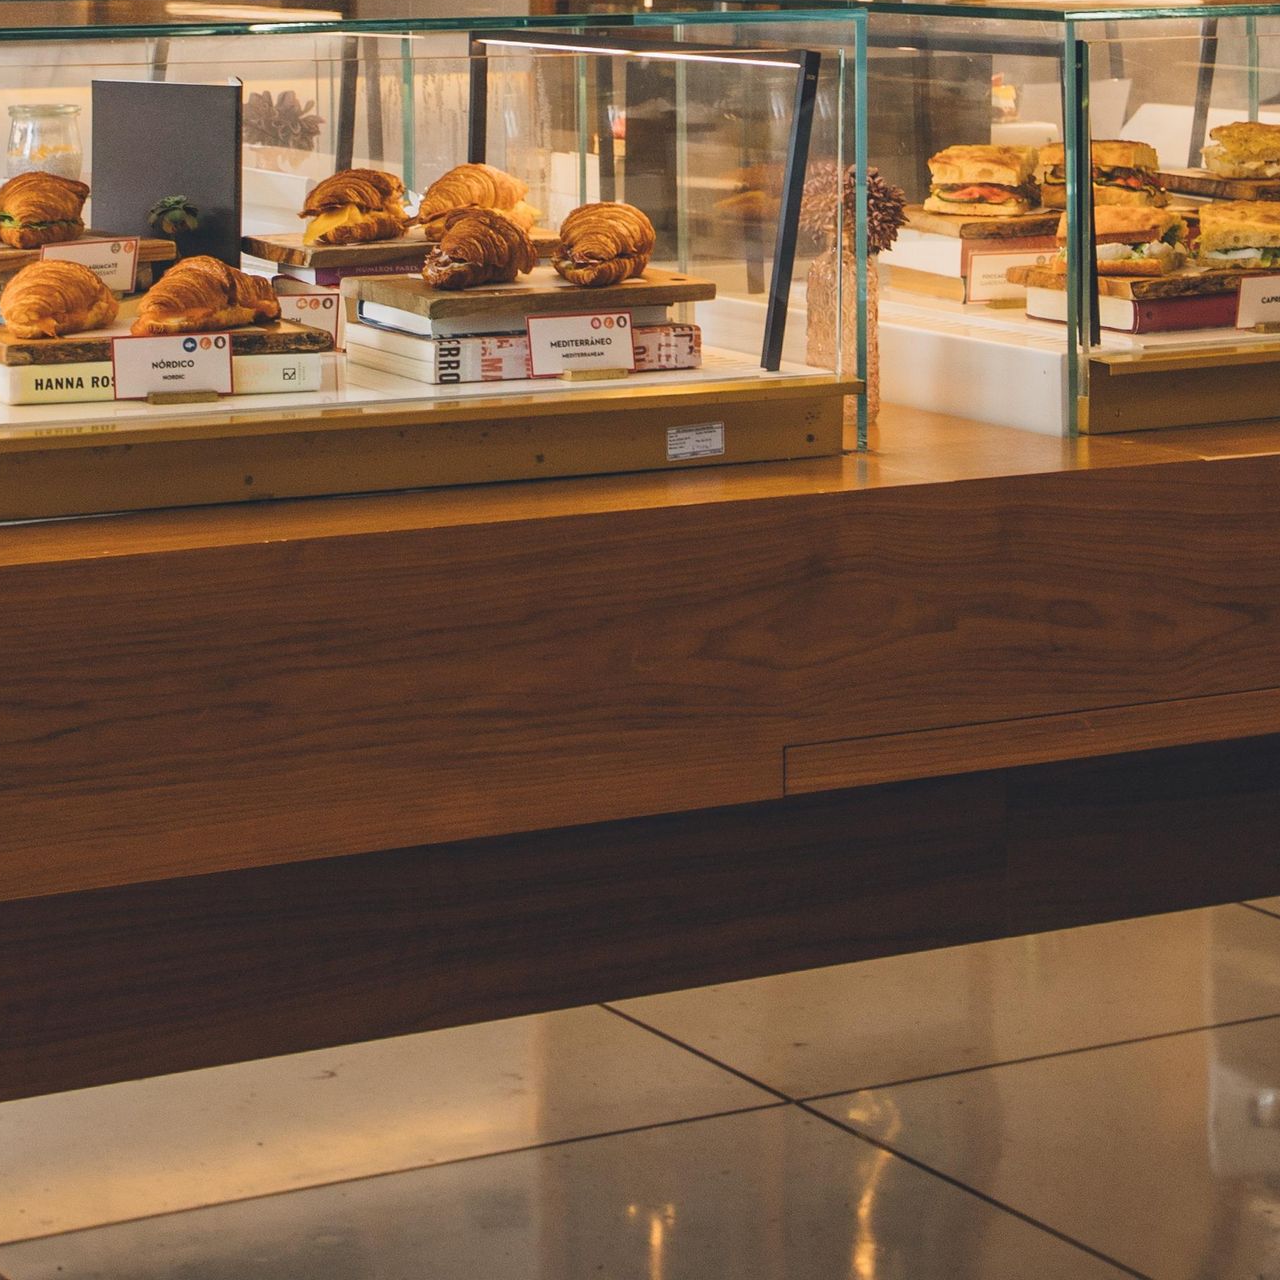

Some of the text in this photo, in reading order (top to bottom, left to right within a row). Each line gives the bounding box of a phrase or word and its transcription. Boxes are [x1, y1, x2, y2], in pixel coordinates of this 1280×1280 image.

[550, 337, 613, 349] MEDITERRÁNEO
[562, 351, 605, 360] MEDITERRANEAN
[151, 358, 195, 370] NÓRDICO
[35, 375, 84, 391] HANNA
[162, 373, 186, 381] NORDIC
